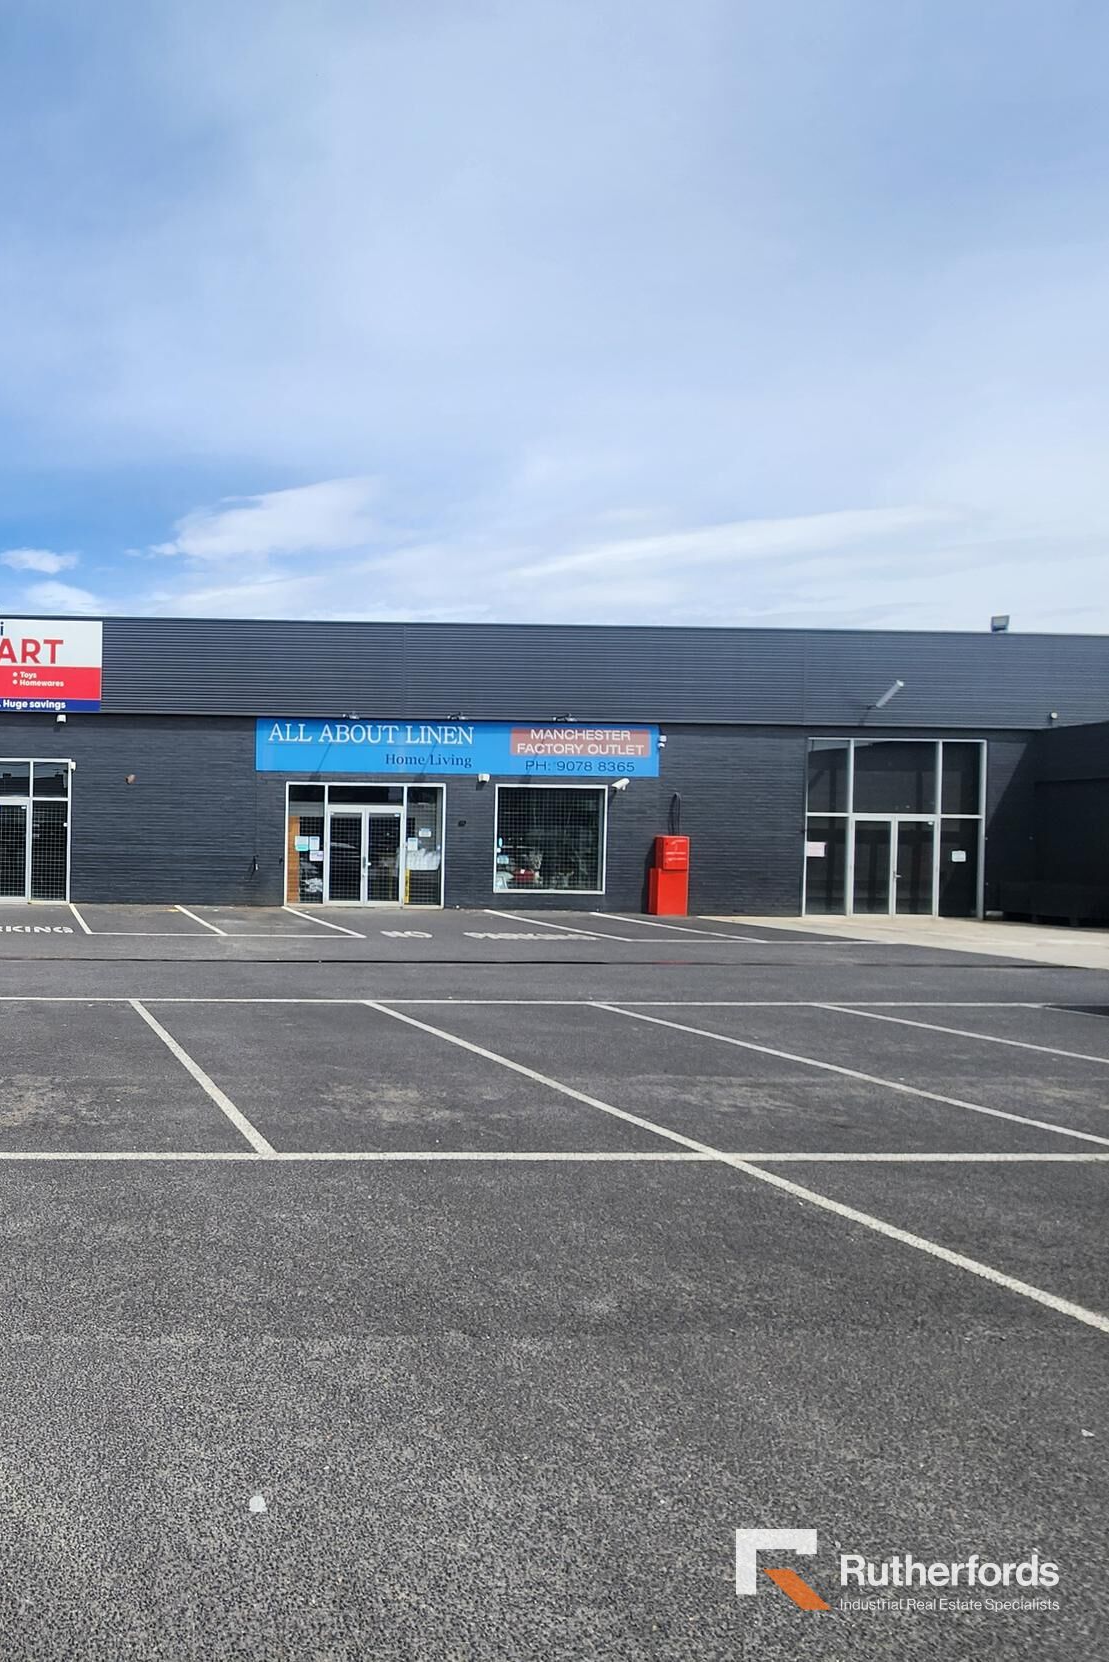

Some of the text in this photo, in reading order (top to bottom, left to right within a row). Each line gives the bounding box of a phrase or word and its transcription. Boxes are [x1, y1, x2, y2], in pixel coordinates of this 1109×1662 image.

[19, 671, 37, 679] Toys
[3, 700, 28, 709] Huge
[29, 700, 66, 710] savings
[268, 723, 474, 745] ALL ABOUT LINEN
[530, 729, 631, 741] MANCHESTER
[517, 743, 644, 756] FACTORY OUTLET
[385, 754, 472, 768] Home Living
[525, 760, 635, 772] PH: 9078 8365
